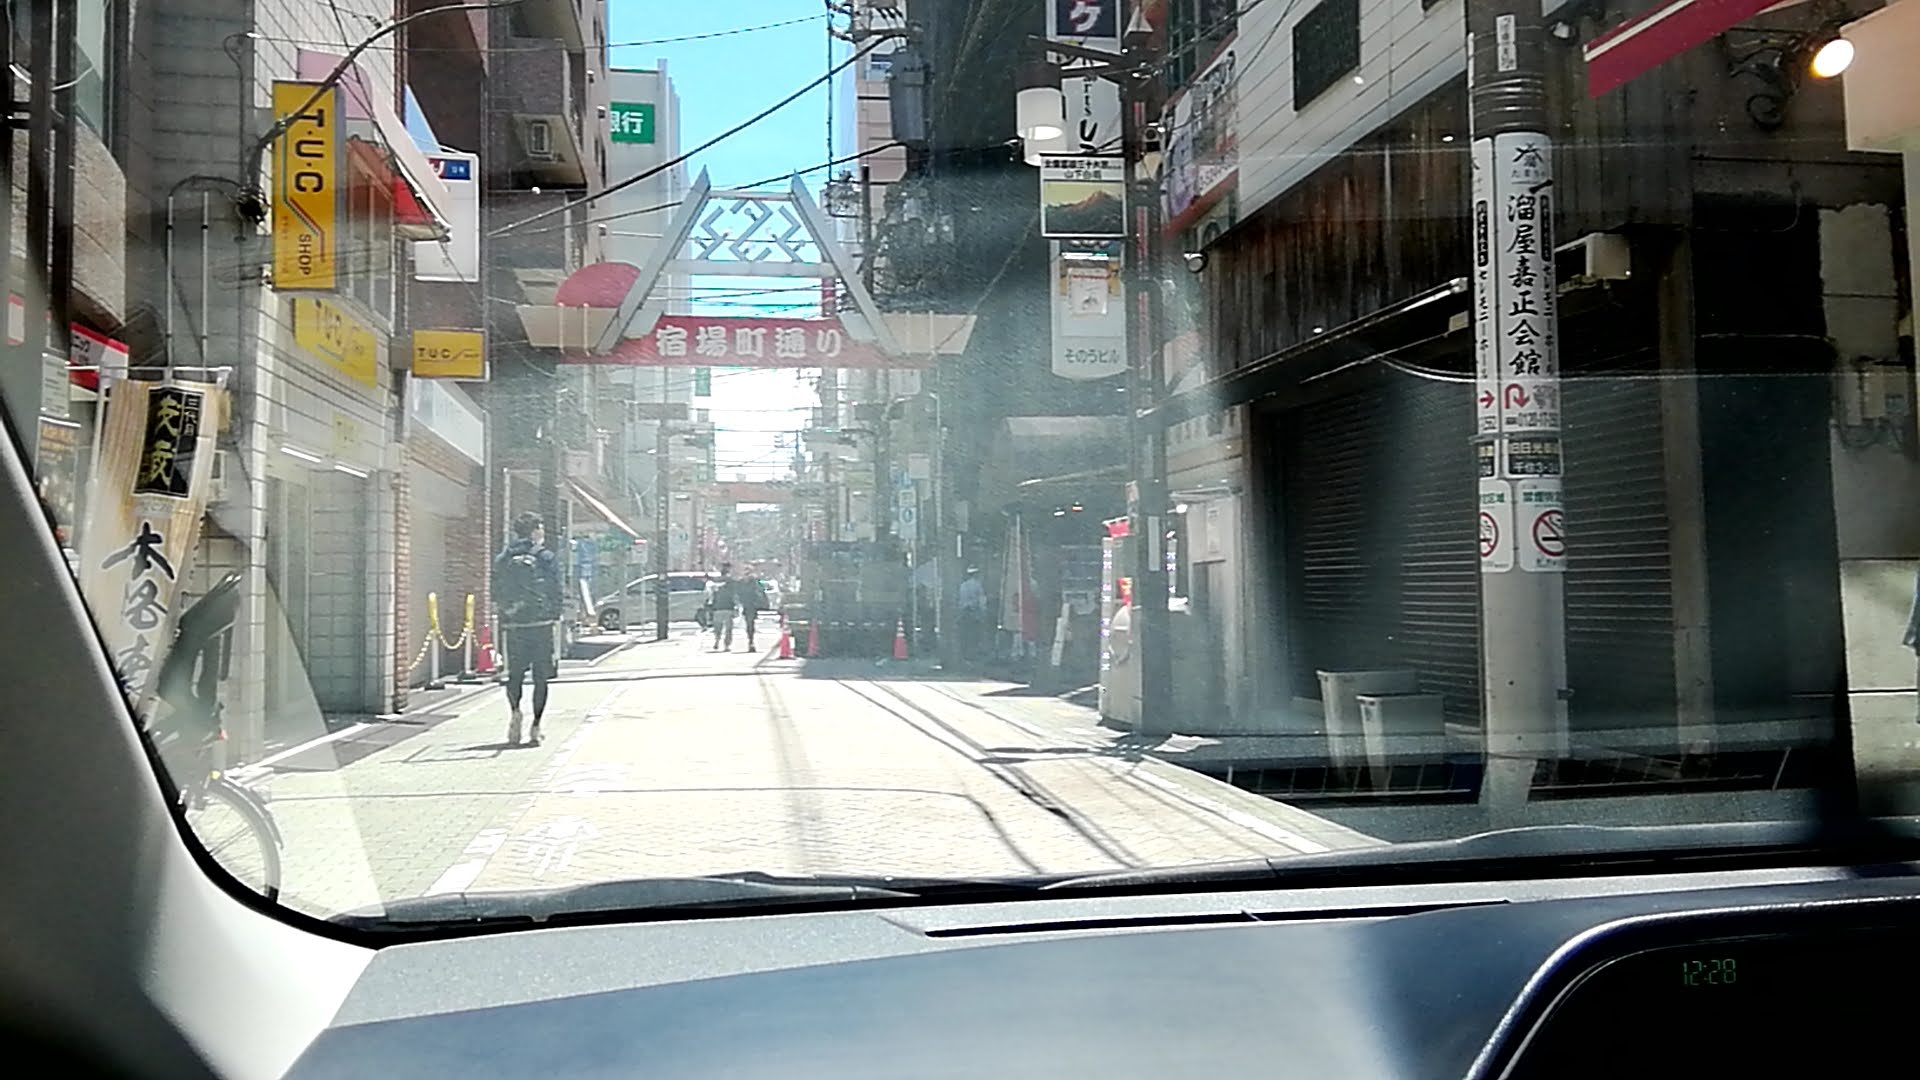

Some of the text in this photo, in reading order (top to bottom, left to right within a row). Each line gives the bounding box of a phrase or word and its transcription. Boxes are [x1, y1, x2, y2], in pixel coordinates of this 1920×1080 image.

[298, 233, 313, 276] SHOP
[656, 325, 842, 358] 宿場町通り
[1683, 958, 1737, 985] 12:28
